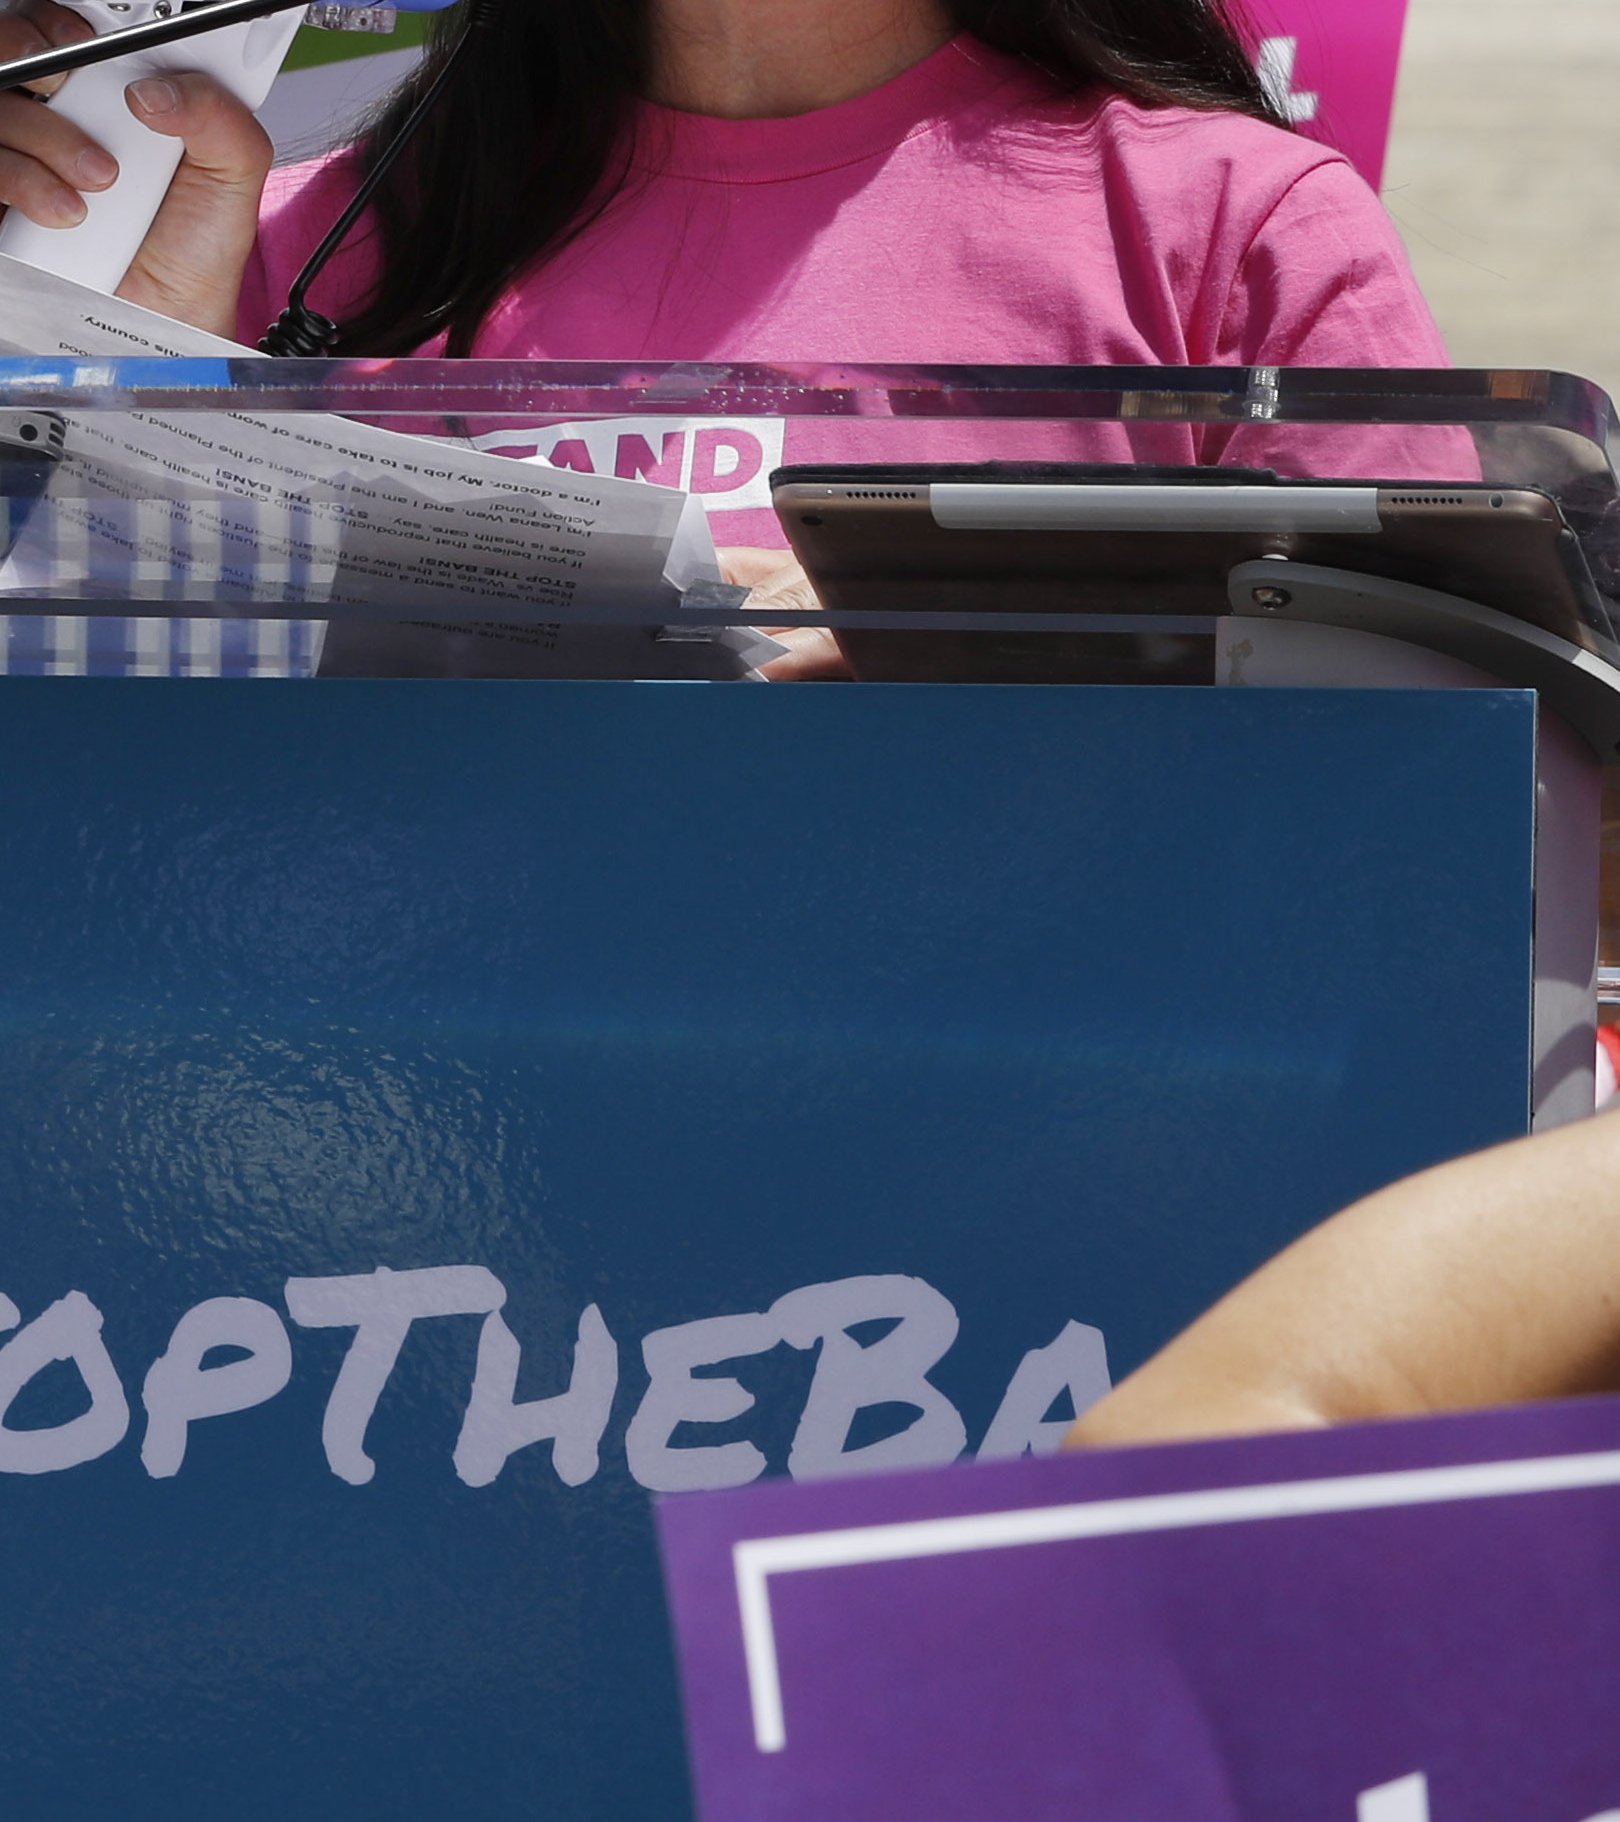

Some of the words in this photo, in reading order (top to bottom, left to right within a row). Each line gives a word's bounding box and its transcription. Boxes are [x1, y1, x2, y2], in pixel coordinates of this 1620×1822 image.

[80, 314, 150, 346] country.
[149, 417, 213, 449] Planned
[272, 427, 290, 437] of
[295, 435, 333, 450] care
[218, 445, 243, 460] the
[337, 448, 375, 463] take
[247, 456, 264, 465] of
[379, 458, 397, 468] to
[163, 459, 210, 484] health
[402, 464, 418, 473] is
[423, 468, 453, 480] job
[216, 468, 271, 493] BANS!
[269, 462, 345, 491] President
[457, 474, 483, 487] My
[216, 480, 229, 490] is
[489, 480, 553, 497] doctor.
[233, 487, 268, 502] care
[351, 486, 376, 498] the
[382, 494, 407, 504] am
[573, 496, 601, 506] I'm
[423, 502, 455, 513] and
[489, 504, 537, 518] Fund!
[392, 518, 422, 529] say
[510, 518, 561, 532] Leana
[542, 512, 596, 527] Action
[567, 527, 591, 538] I'm
[435, 538, 467, 549] that
[474, 534, 525, 547] health
[531, 542, 544, 551] is
[472, 544, 531, 560] believe
[549, 546, 586, 557] care
[537, 554, 567, 565] you
[525, 576, 576, 589] STOP
